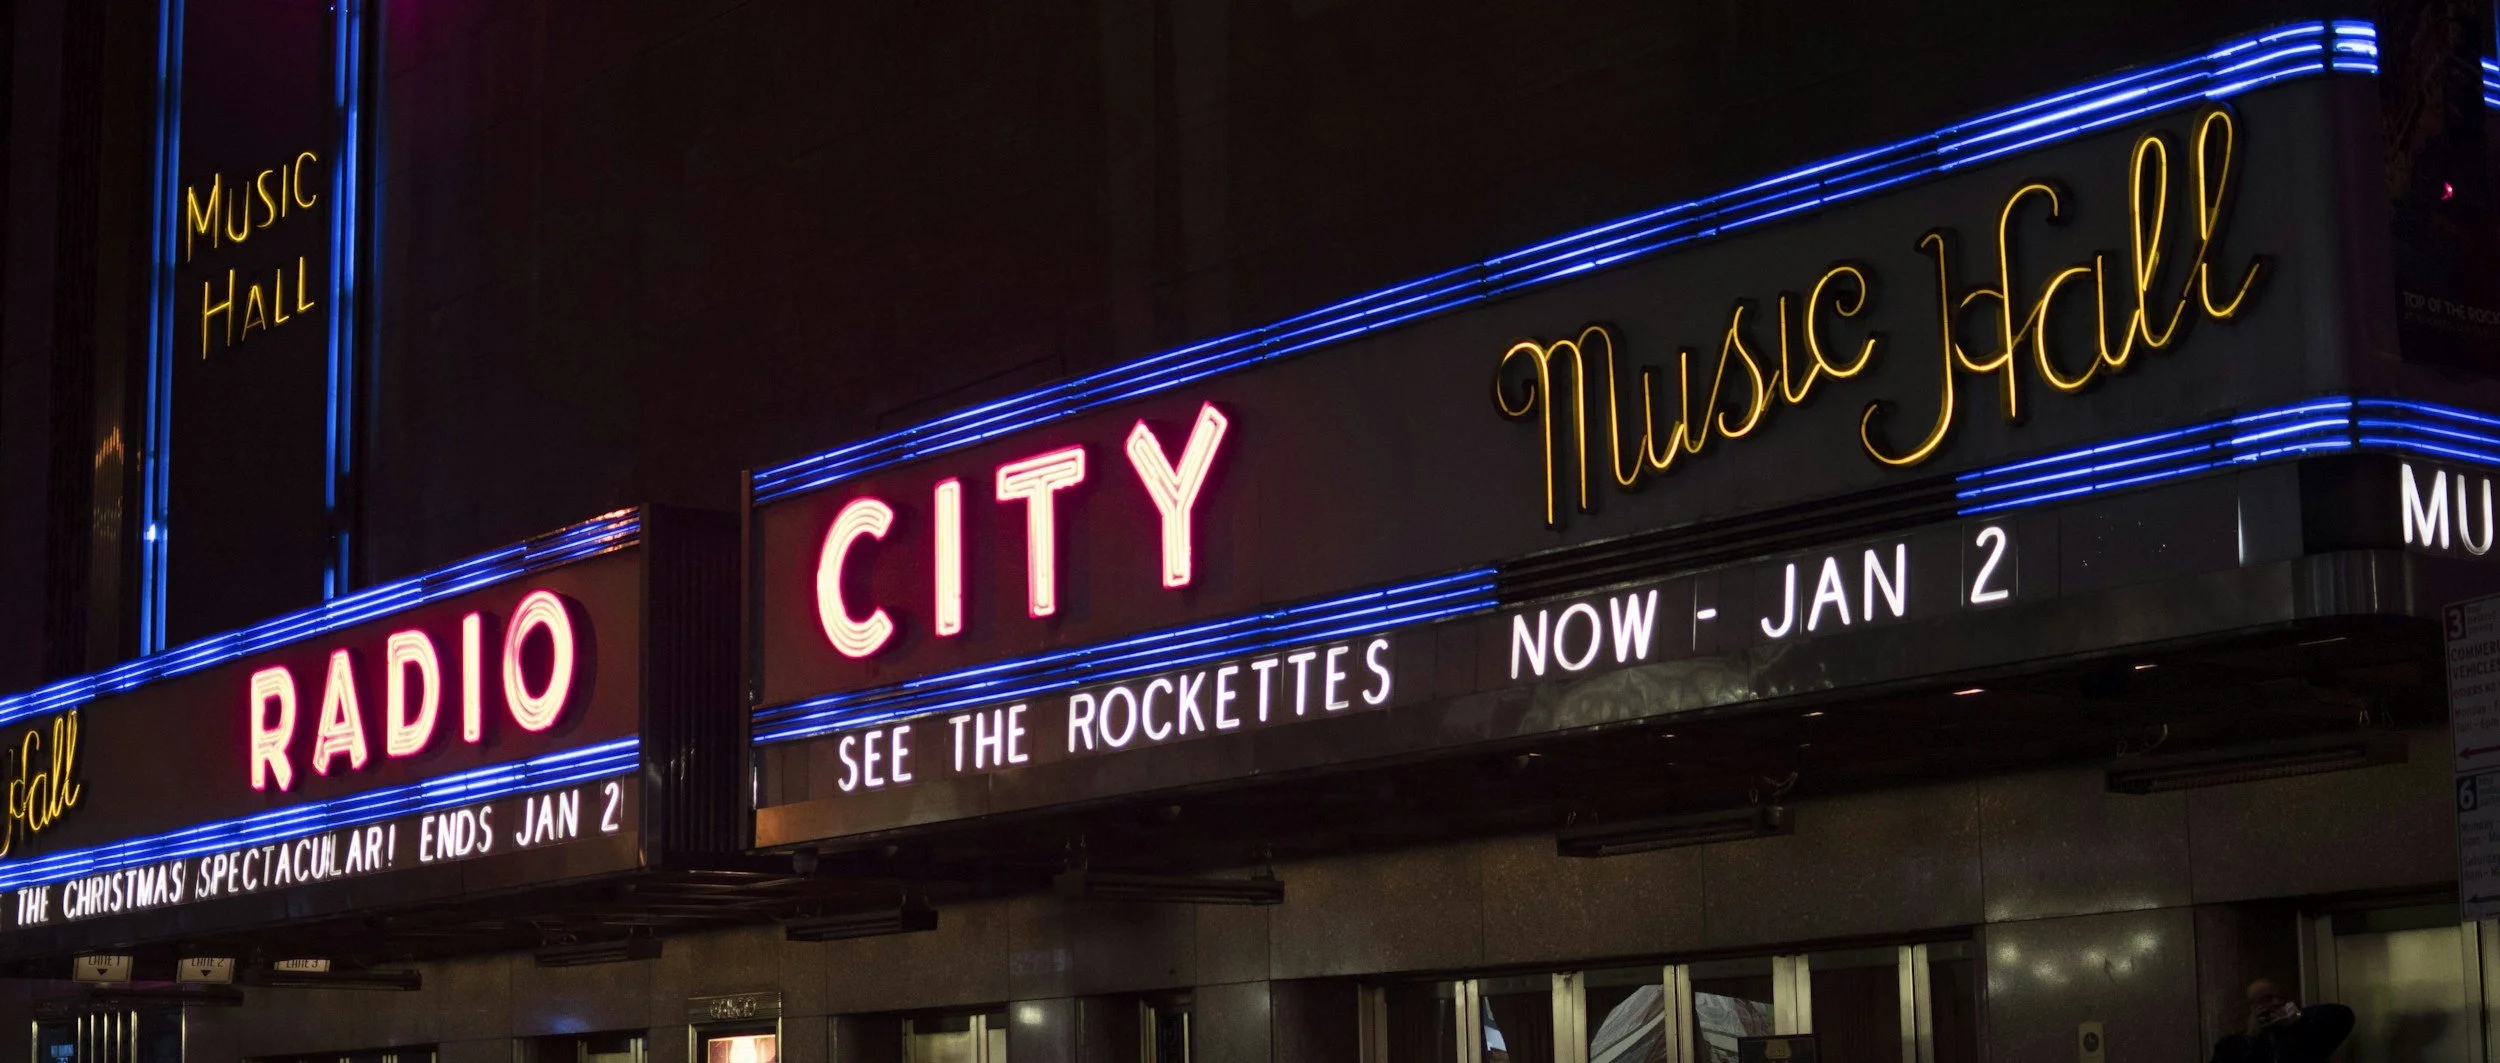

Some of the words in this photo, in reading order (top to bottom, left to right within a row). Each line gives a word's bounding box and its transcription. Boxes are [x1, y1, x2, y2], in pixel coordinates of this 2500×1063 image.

[187, 150, 319, 264] MUSIC
[202, 255, 315, 361] HALL
[1495, 265, 1877, 525] Music
[1861, 110, 2261, 466] Hall
[2402, 291, 2425, 309] TOP
[815, 400, 1229, 660] CITY
[2401, 463, 2494, 556] MU
[838, 725, 913, 793] SEE
[949, 703, 1029, 772] THE
[1067, 638, 1393, 753] ROCKETTES
[1510, 590, 1659, 680] NOW
[1696, 608, 1718, 620] -
[1760, 544, 1906, 639] JAN
[1970, 526, 2010, 604] 2
[2448, 609, 2463, 638] 3
[250, 589, 575, 791] RADIO
[2459, 779, 2474, 810] 6
[17, 885, 51, 926] THE
[63, 867, 184, 922] CHRISTMAS
[199, 822, 396, 899] SPECTACULAR!
[420, 806, 494, 865] ENDS
[516, 783, 580, 848] JAN
[600, 781, 620, 833] 2
